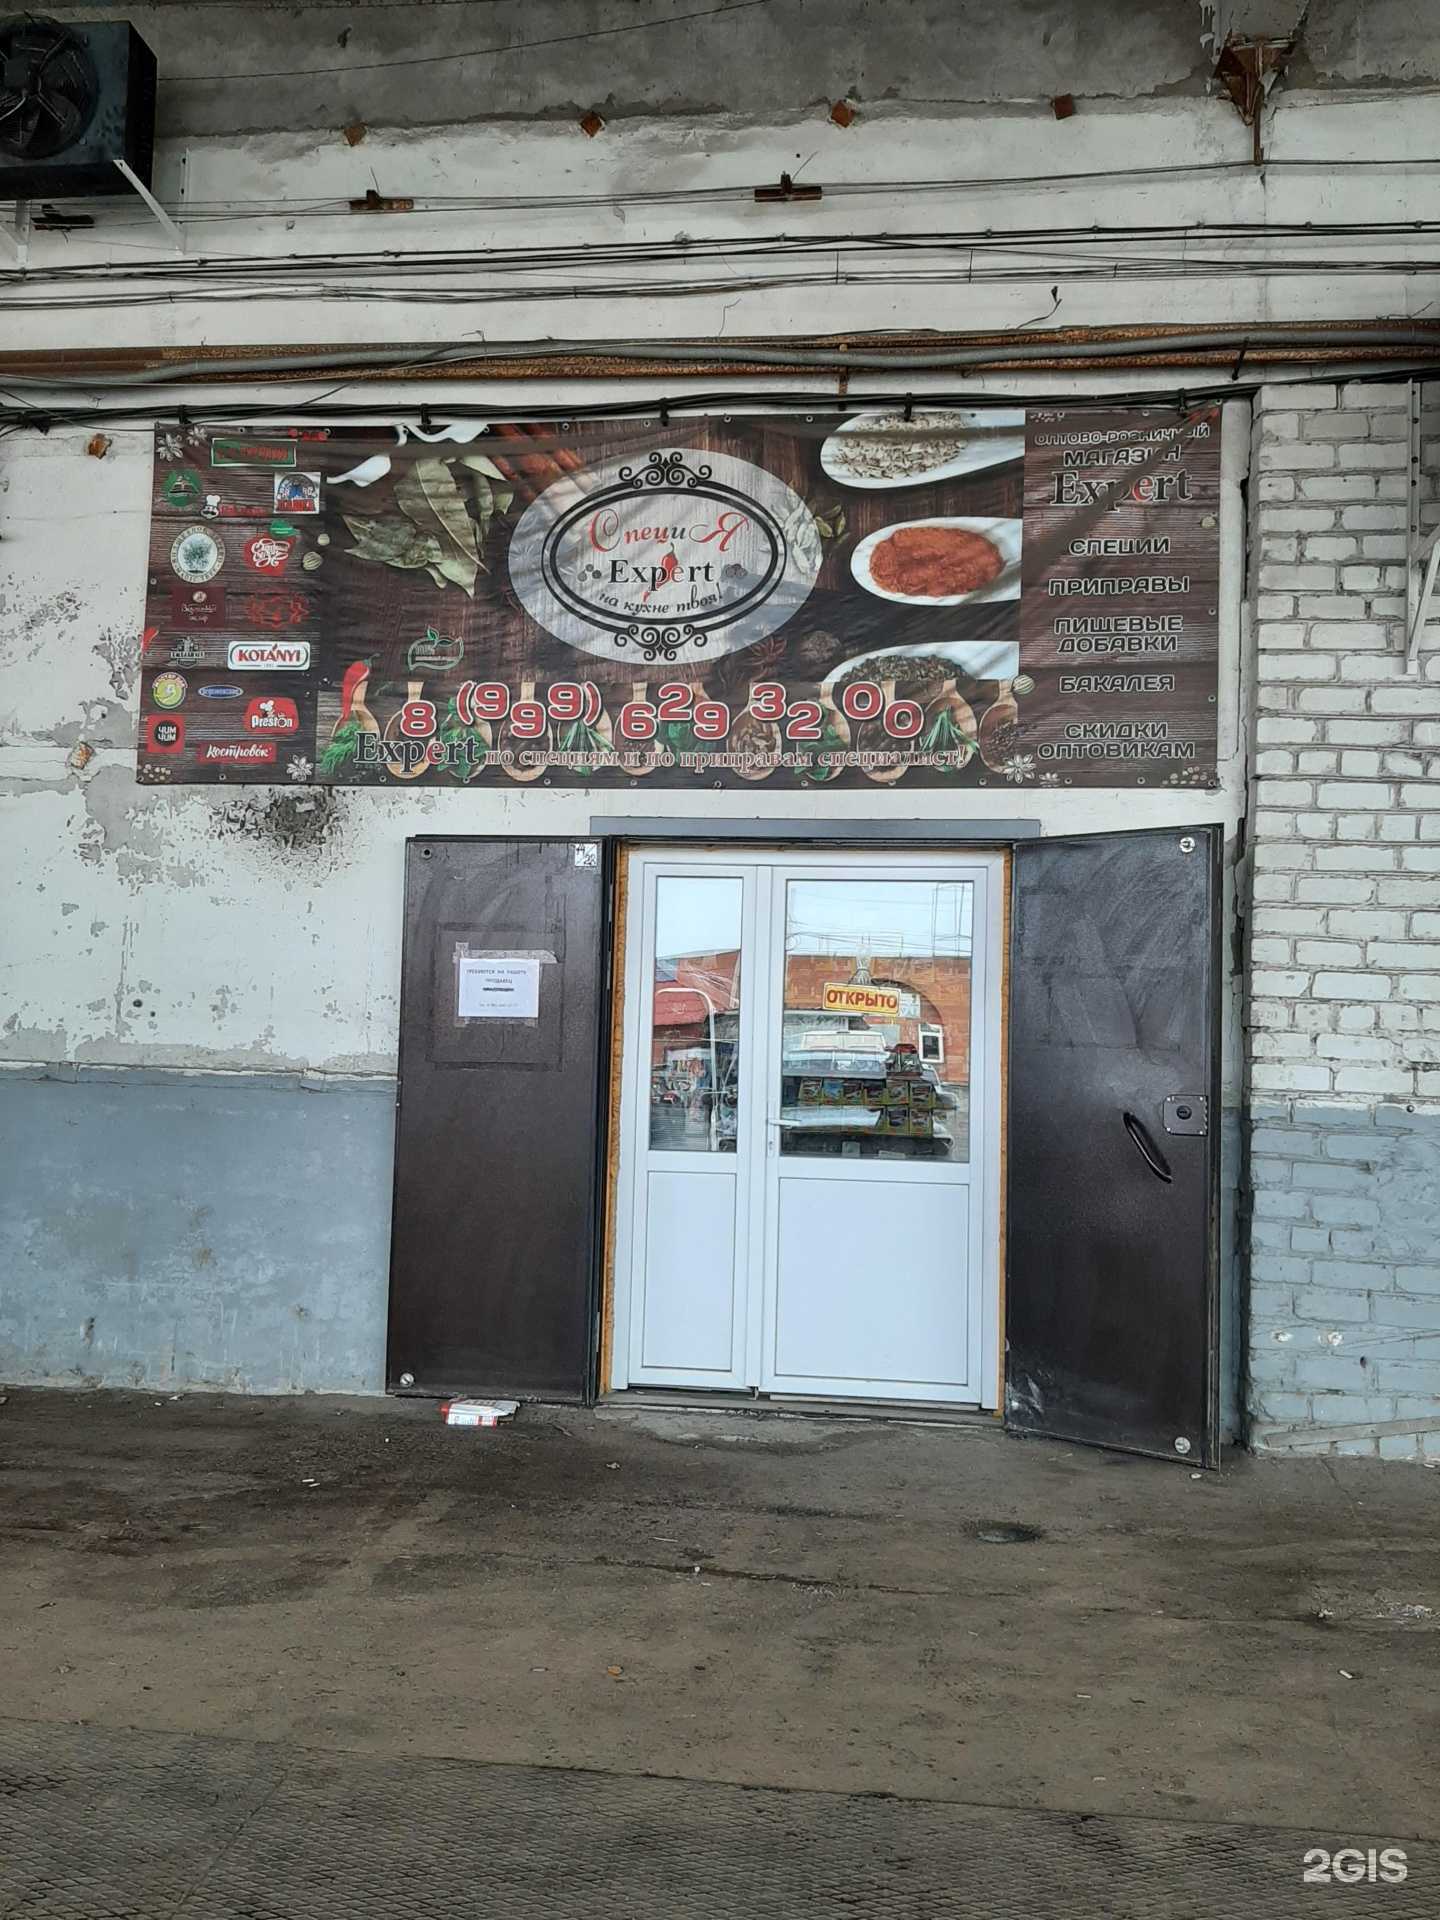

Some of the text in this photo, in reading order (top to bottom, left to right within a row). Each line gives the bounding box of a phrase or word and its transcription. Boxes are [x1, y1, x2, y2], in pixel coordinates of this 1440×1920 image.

[1069, 536, 1170, 556] СПЕЦИИ
[608, 559, 714, 592] Expert
[1049, 575, 1190, 596] ПРИПРАВЫ
[598, 582, 723, 616] на кухне твоя!
[1054, 615, 1184, 635] ПИЩЕВЫЕ
[1057, 635, 1178, 655] ДОБАВКИ
[1059, 674, 1175, 694] БАКАЛЕЯ
[401, 680, 924, 740] 8 (999) 629 32 00
[251, 714, 293, 728] Preston
[1064, 721, 1168, 740] СКИДКИ
[353, 731, 968, 774] Expert по специям и по приправам специалист!
[1037, 741, 1196, 760] ОПТОВИКАМ
[827, 989, 898, 1009] ОТКРЫТО
